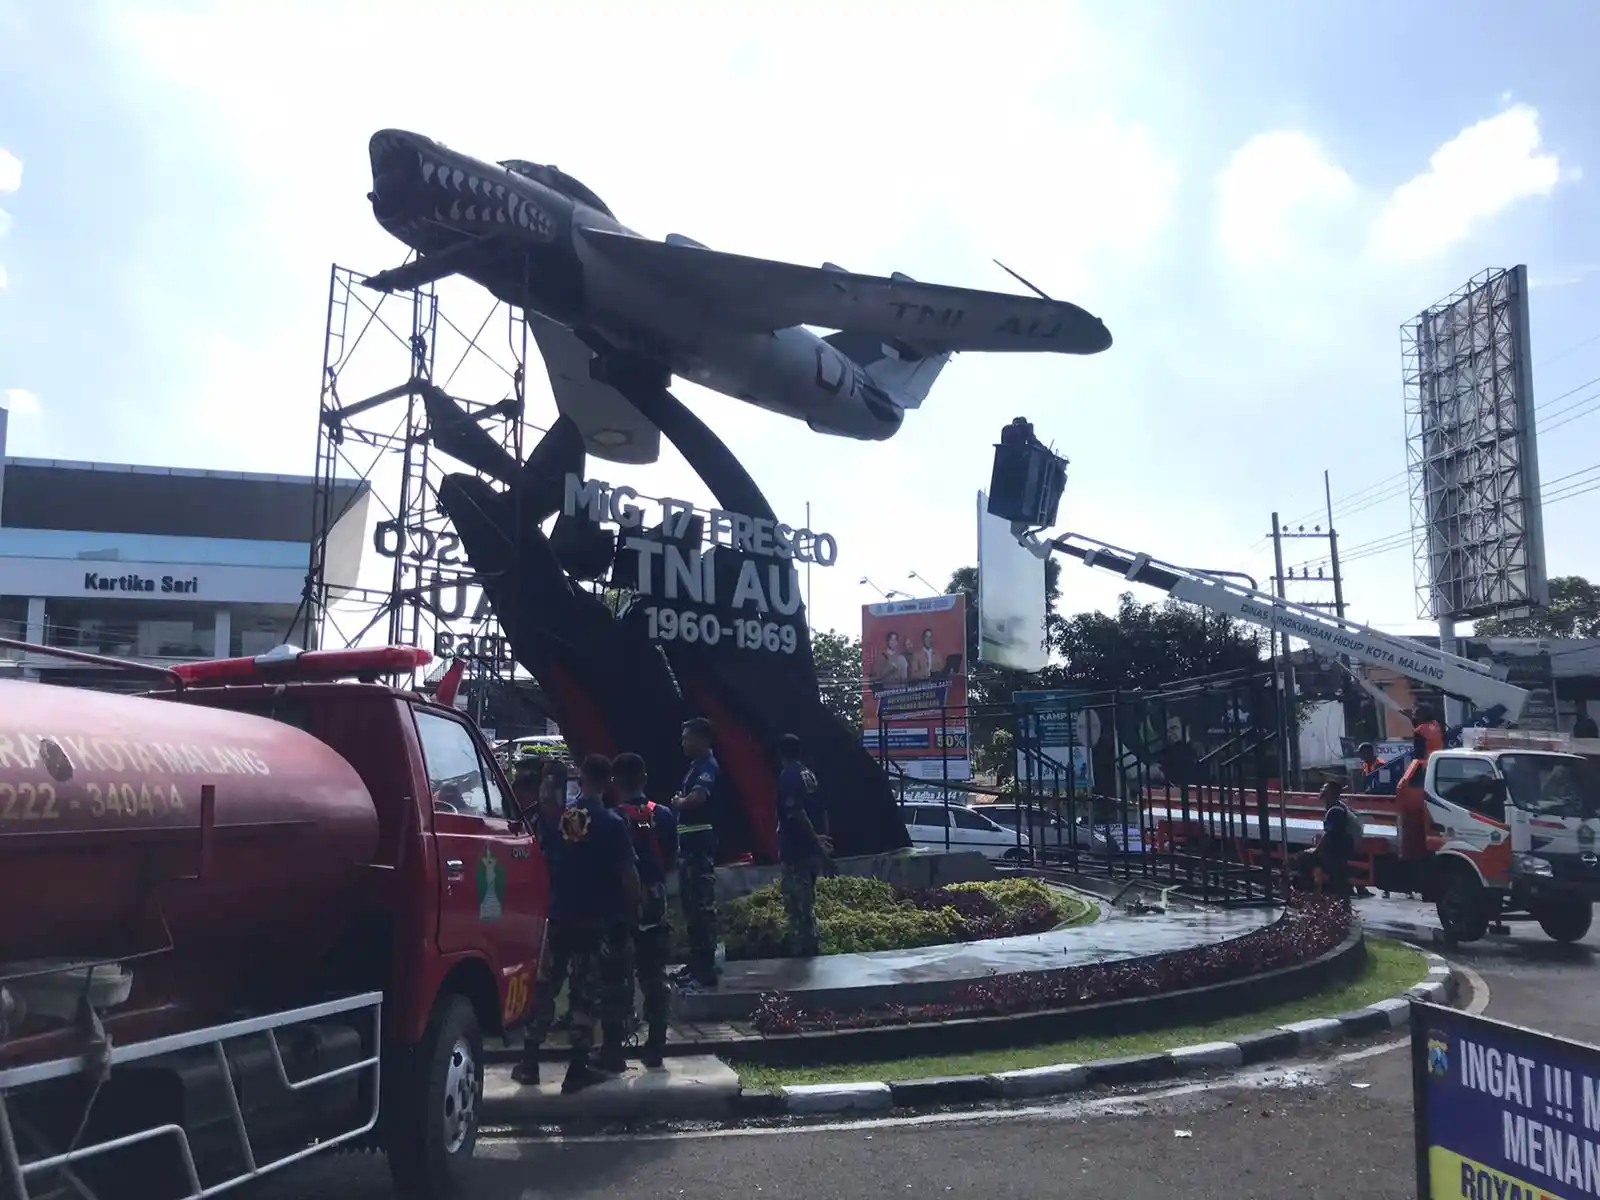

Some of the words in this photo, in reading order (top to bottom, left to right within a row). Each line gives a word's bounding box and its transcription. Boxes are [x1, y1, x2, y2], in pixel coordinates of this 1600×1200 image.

[564, 472, 641, 528] MiG
[658, 497, 694, 539] 17
[710, 508, 838, 567] FRESCO
[84, 572, 155, 592] Kartika
[161, 575, 198, 593] Sari
[626, 536, 716, 605] TNI
[731, 560, 802, 616] AU
[644, 606, 798, 655] 1960-1969
[1240, 603, 1268, 620] DINAS
[1333, 634, 1365, 652] HIDUP
[1365, 645, 1397, 664] KOTA
[1397, 657, 1445, 680] MALANG
[64, 735, 164, 773] KOTA
[152, 741, 271, 776] MALANG
[936, 733, 965, 748] 50%
[1460, 1038, 1536, 1108] INGAT
[1543, 1063, 1574, 1123] !!!
